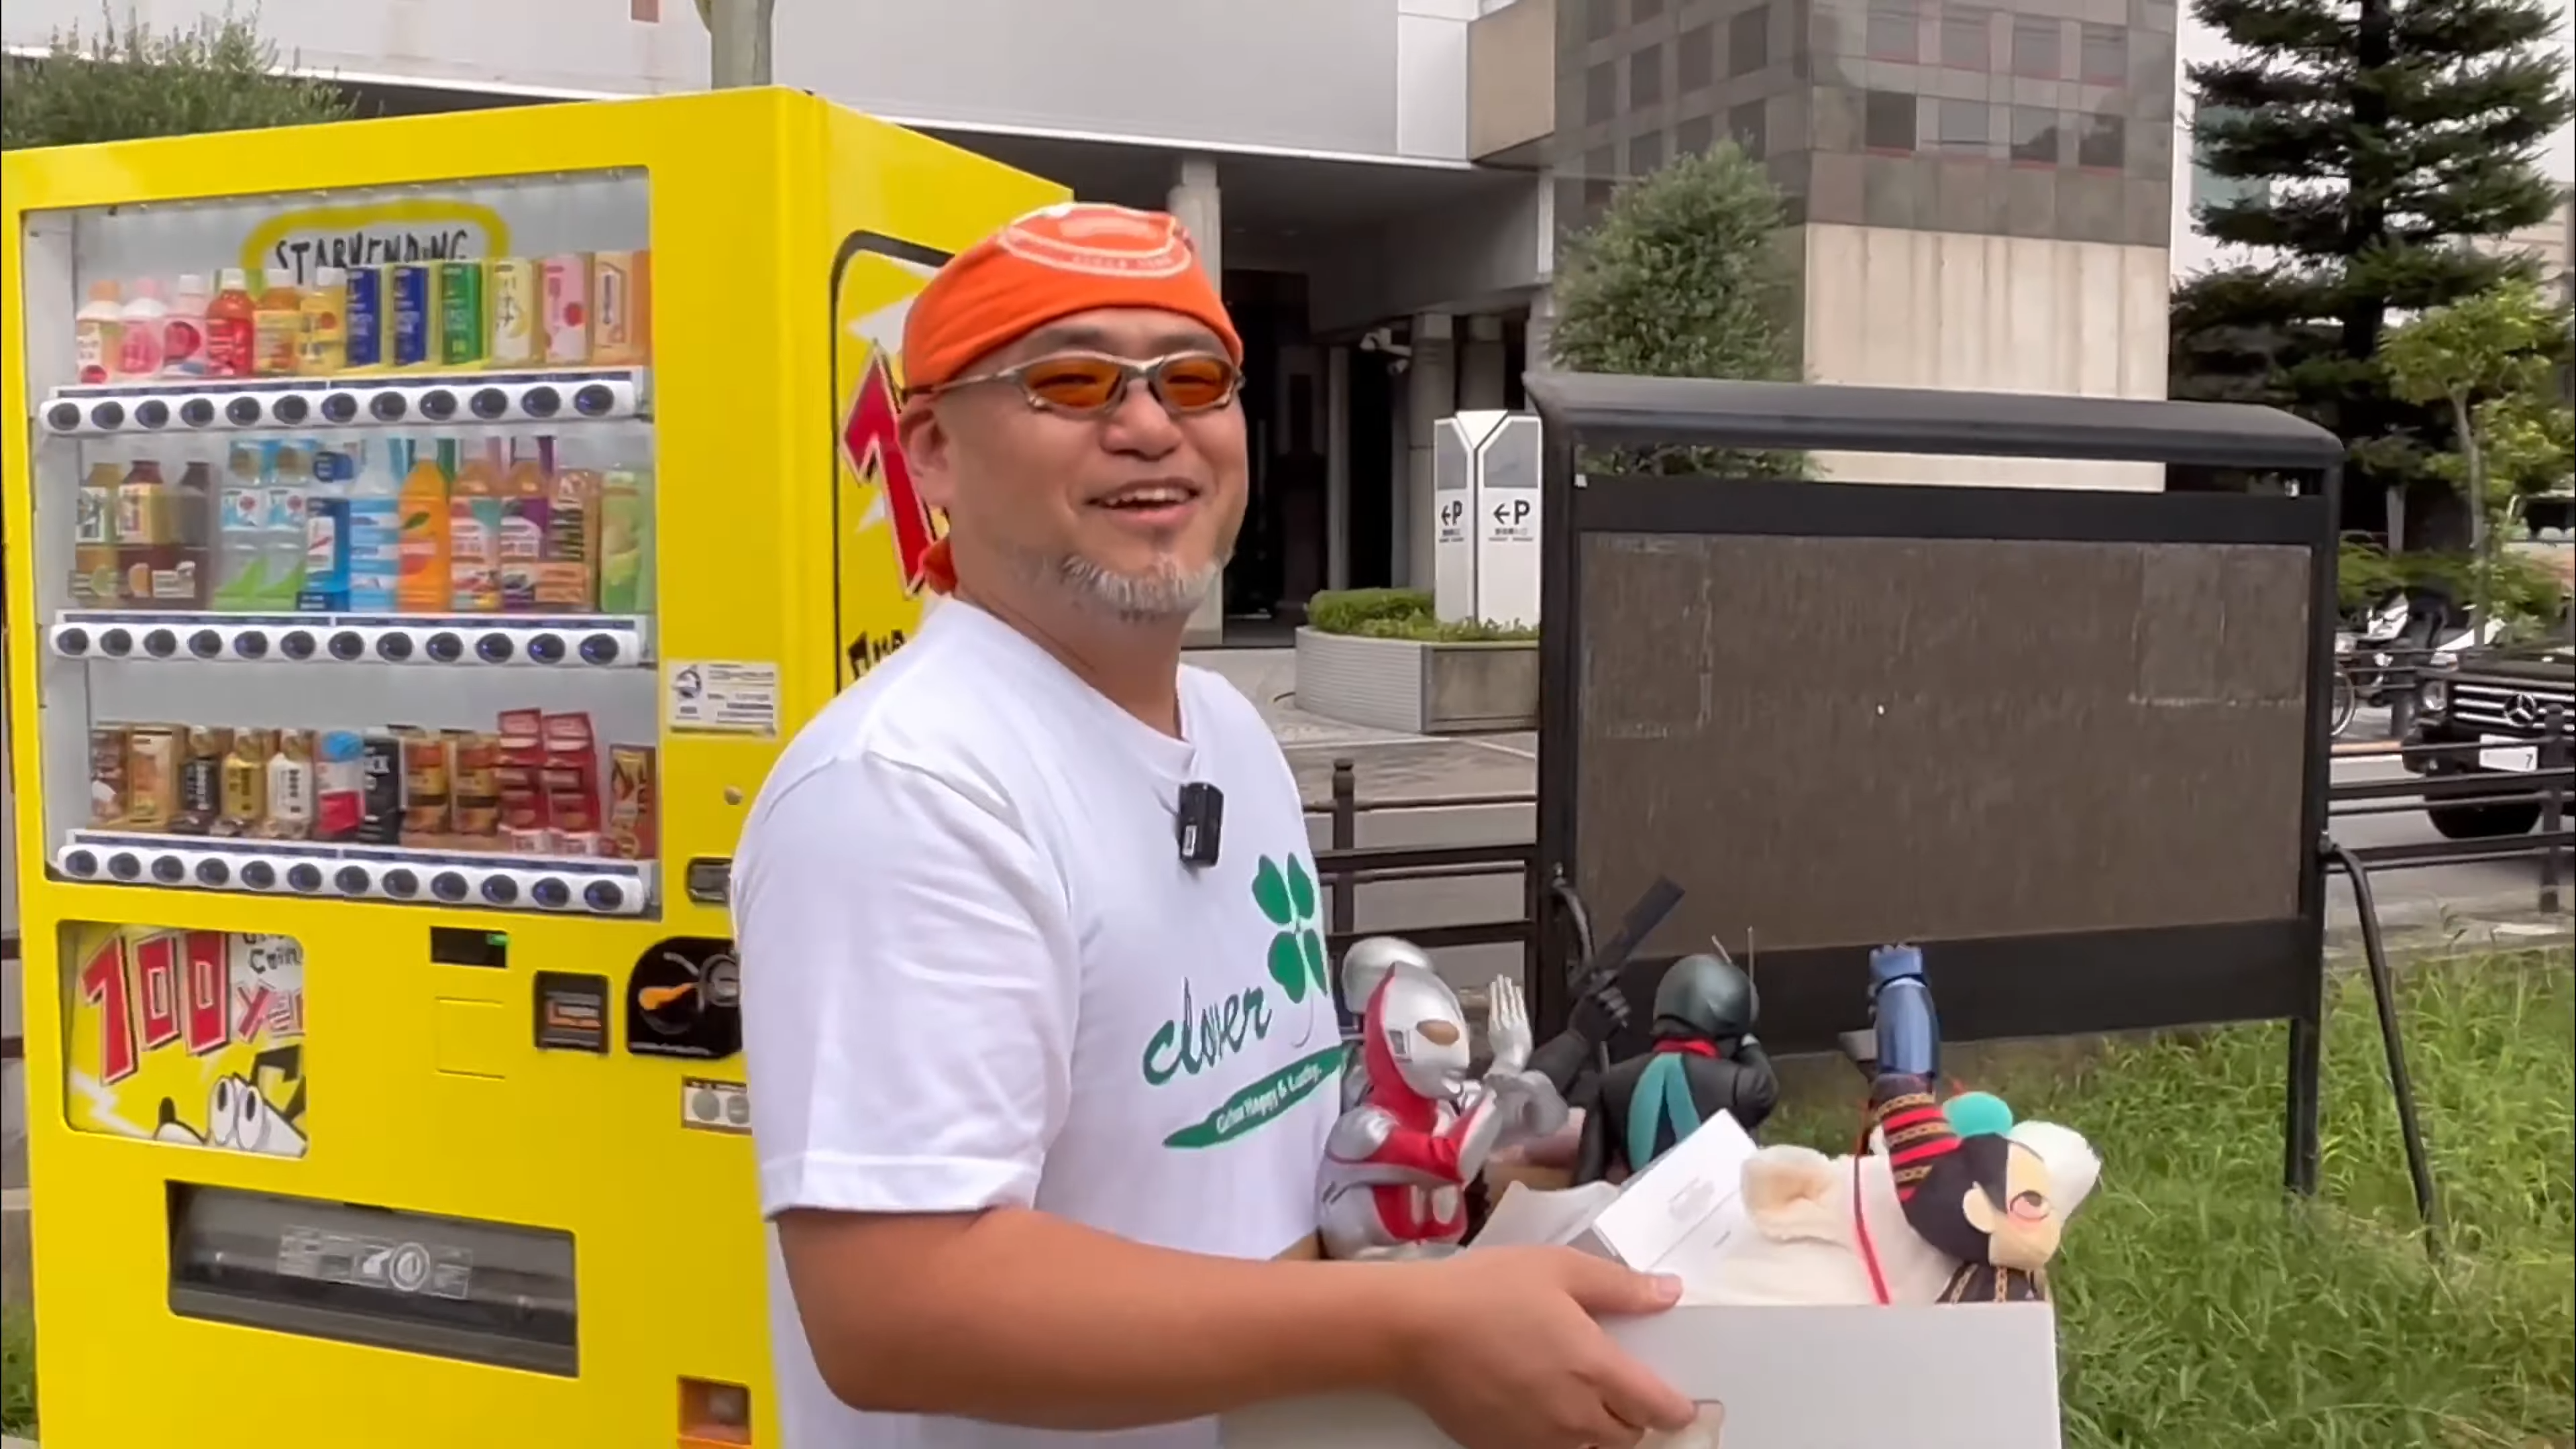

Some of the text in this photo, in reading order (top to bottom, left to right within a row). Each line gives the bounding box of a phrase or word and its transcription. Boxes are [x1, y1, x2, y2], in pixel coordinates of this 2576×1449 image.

[1452, 500, 1463, 526] P
[1514, 500, 1530, 525] P
[80, 931, 231, 1087] 100
[1142, 976, 1273, 1085] clover
